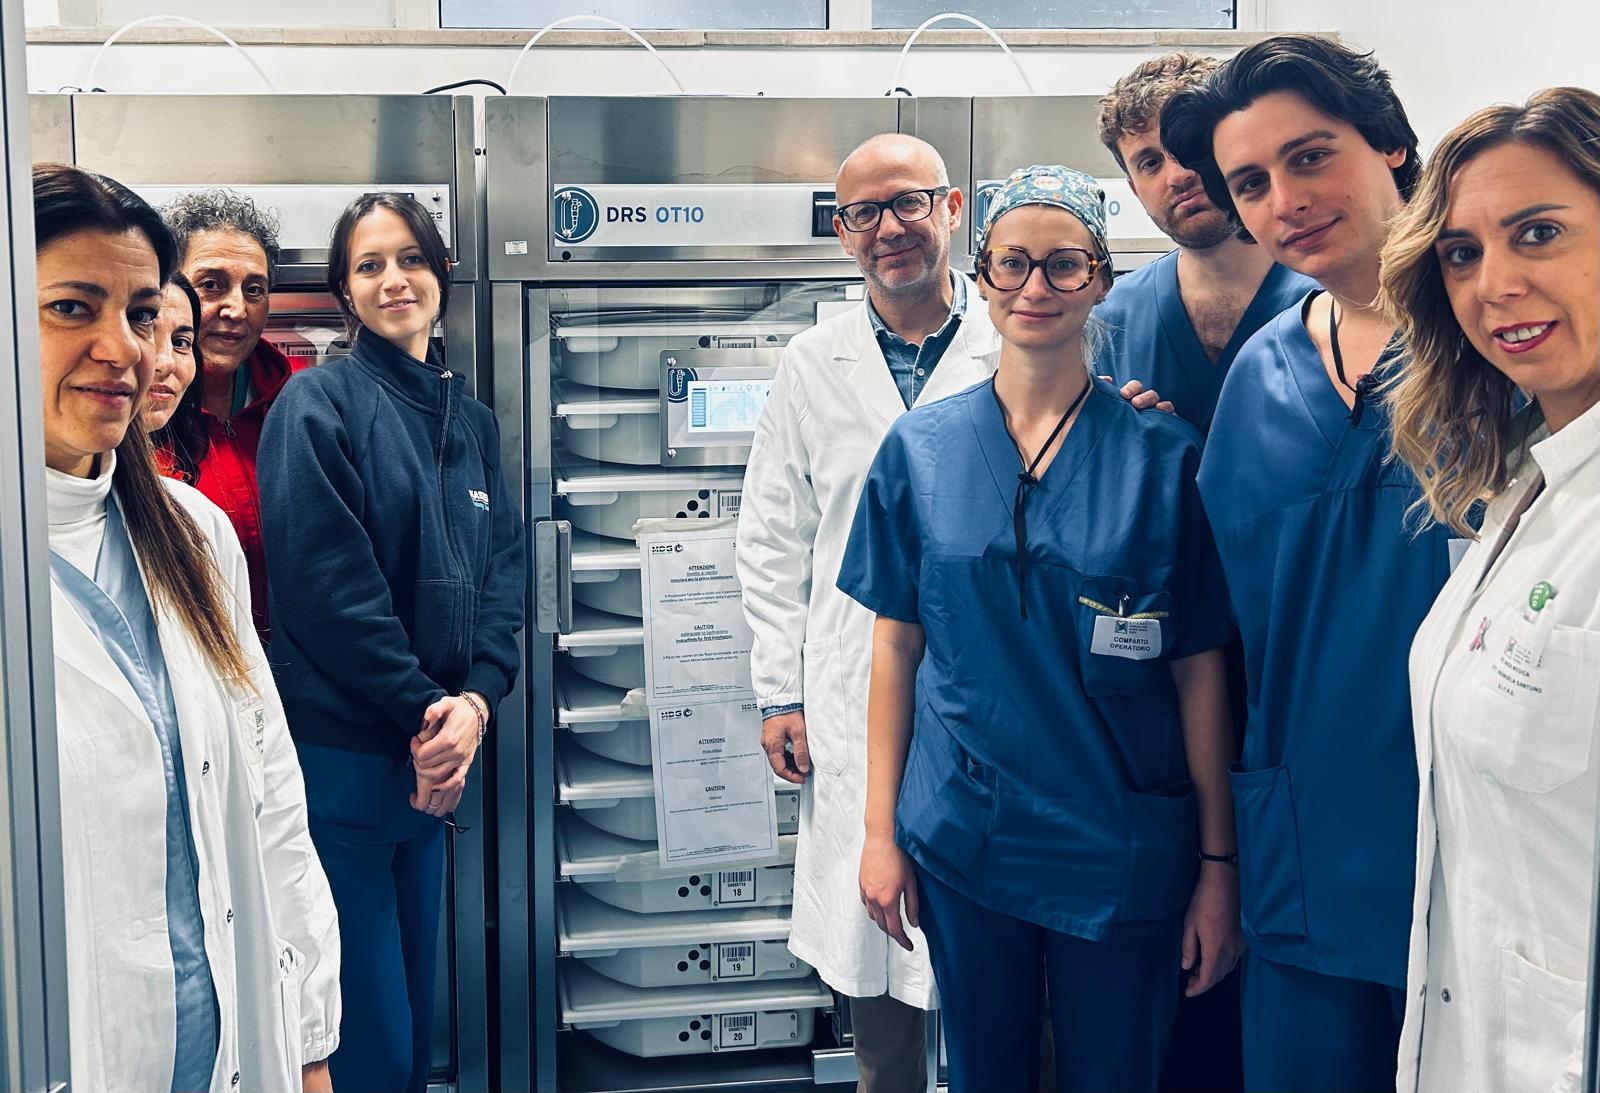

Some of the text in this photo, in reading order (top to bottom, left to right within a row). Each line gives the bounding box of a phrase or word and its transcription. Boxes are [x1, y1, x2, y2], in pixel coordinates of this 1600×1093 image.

[606, 206, 704, 223] DRS OT10
[1113, 636, 1149, 645] COMPARTO
[1109, 643, 1151, 652] OPERATORIO
[698, 737, 726, 745] ATTENZIONE
[733, 888, 742, 897] 18
[732, 963, 741, 972] 19
[733, 1033, 743, 1041] 20
